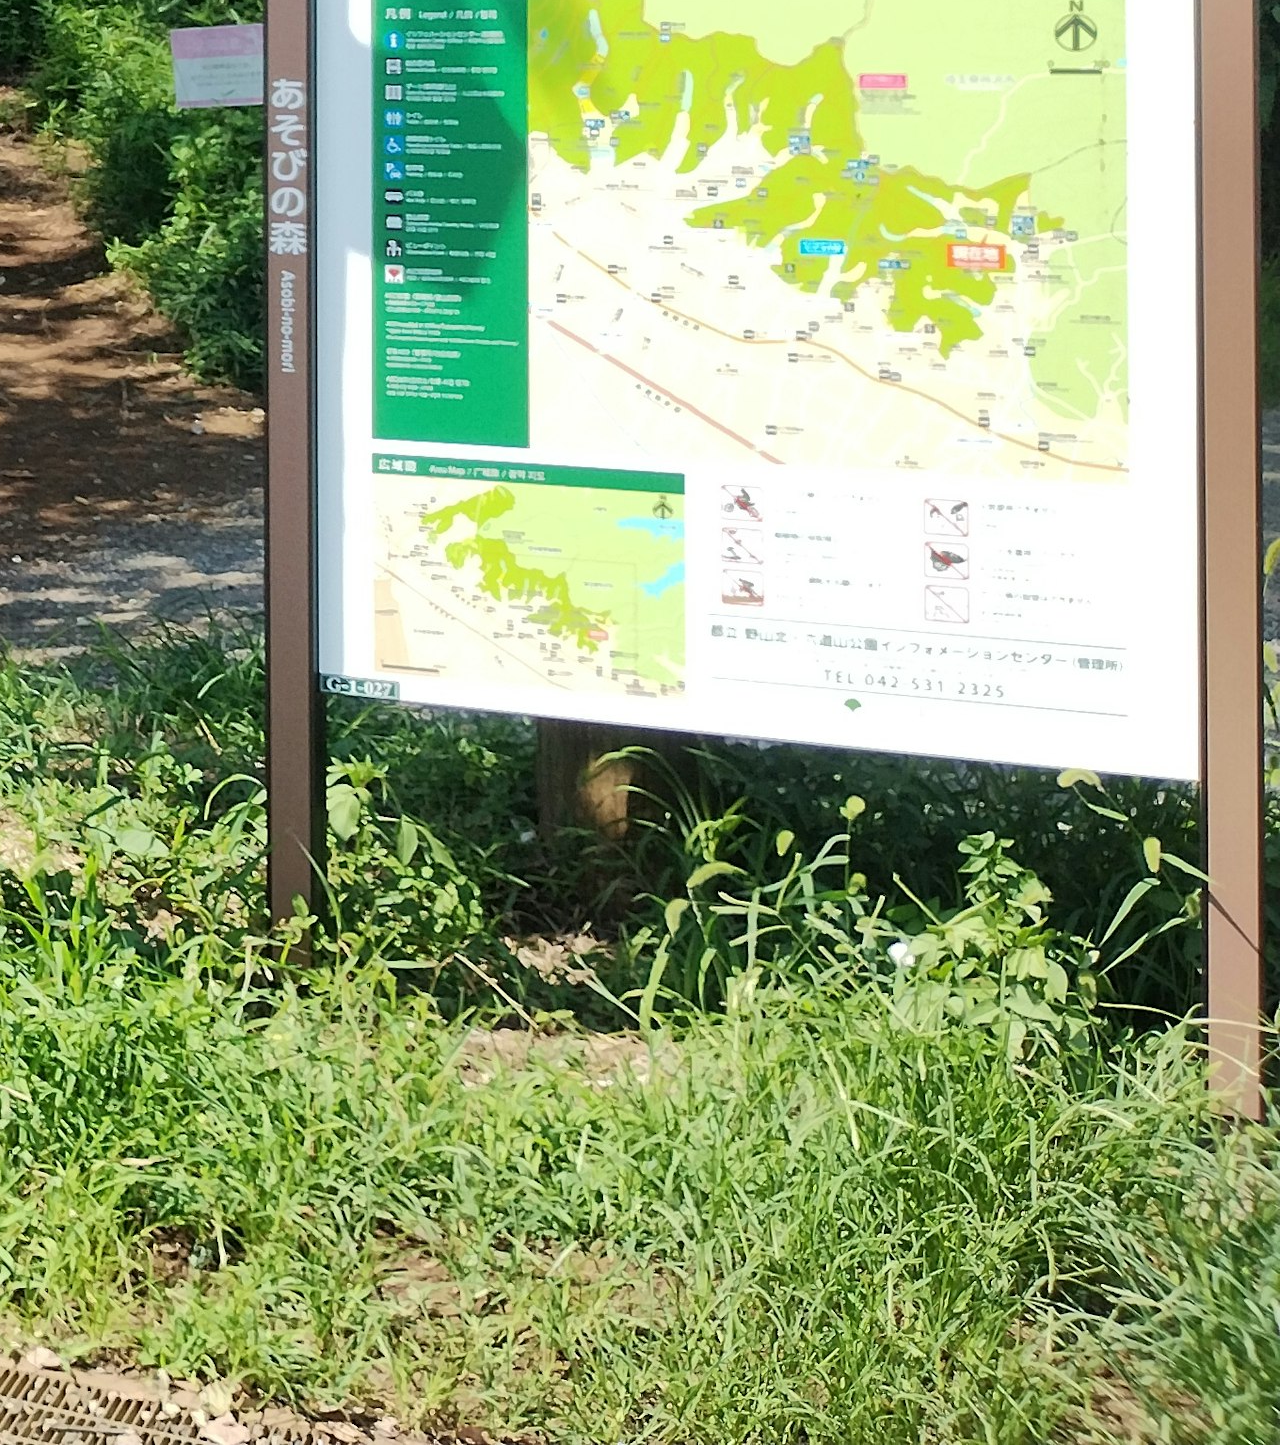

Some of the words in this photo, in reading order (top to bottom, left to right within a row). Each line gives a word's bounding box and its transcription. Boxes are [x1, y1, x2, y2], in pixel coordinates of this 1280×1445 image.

[268, 77, 308, 255] あそびの森
[326, 676, 392, 697] G-1-027
[824, 669, 854, 685] TEL
